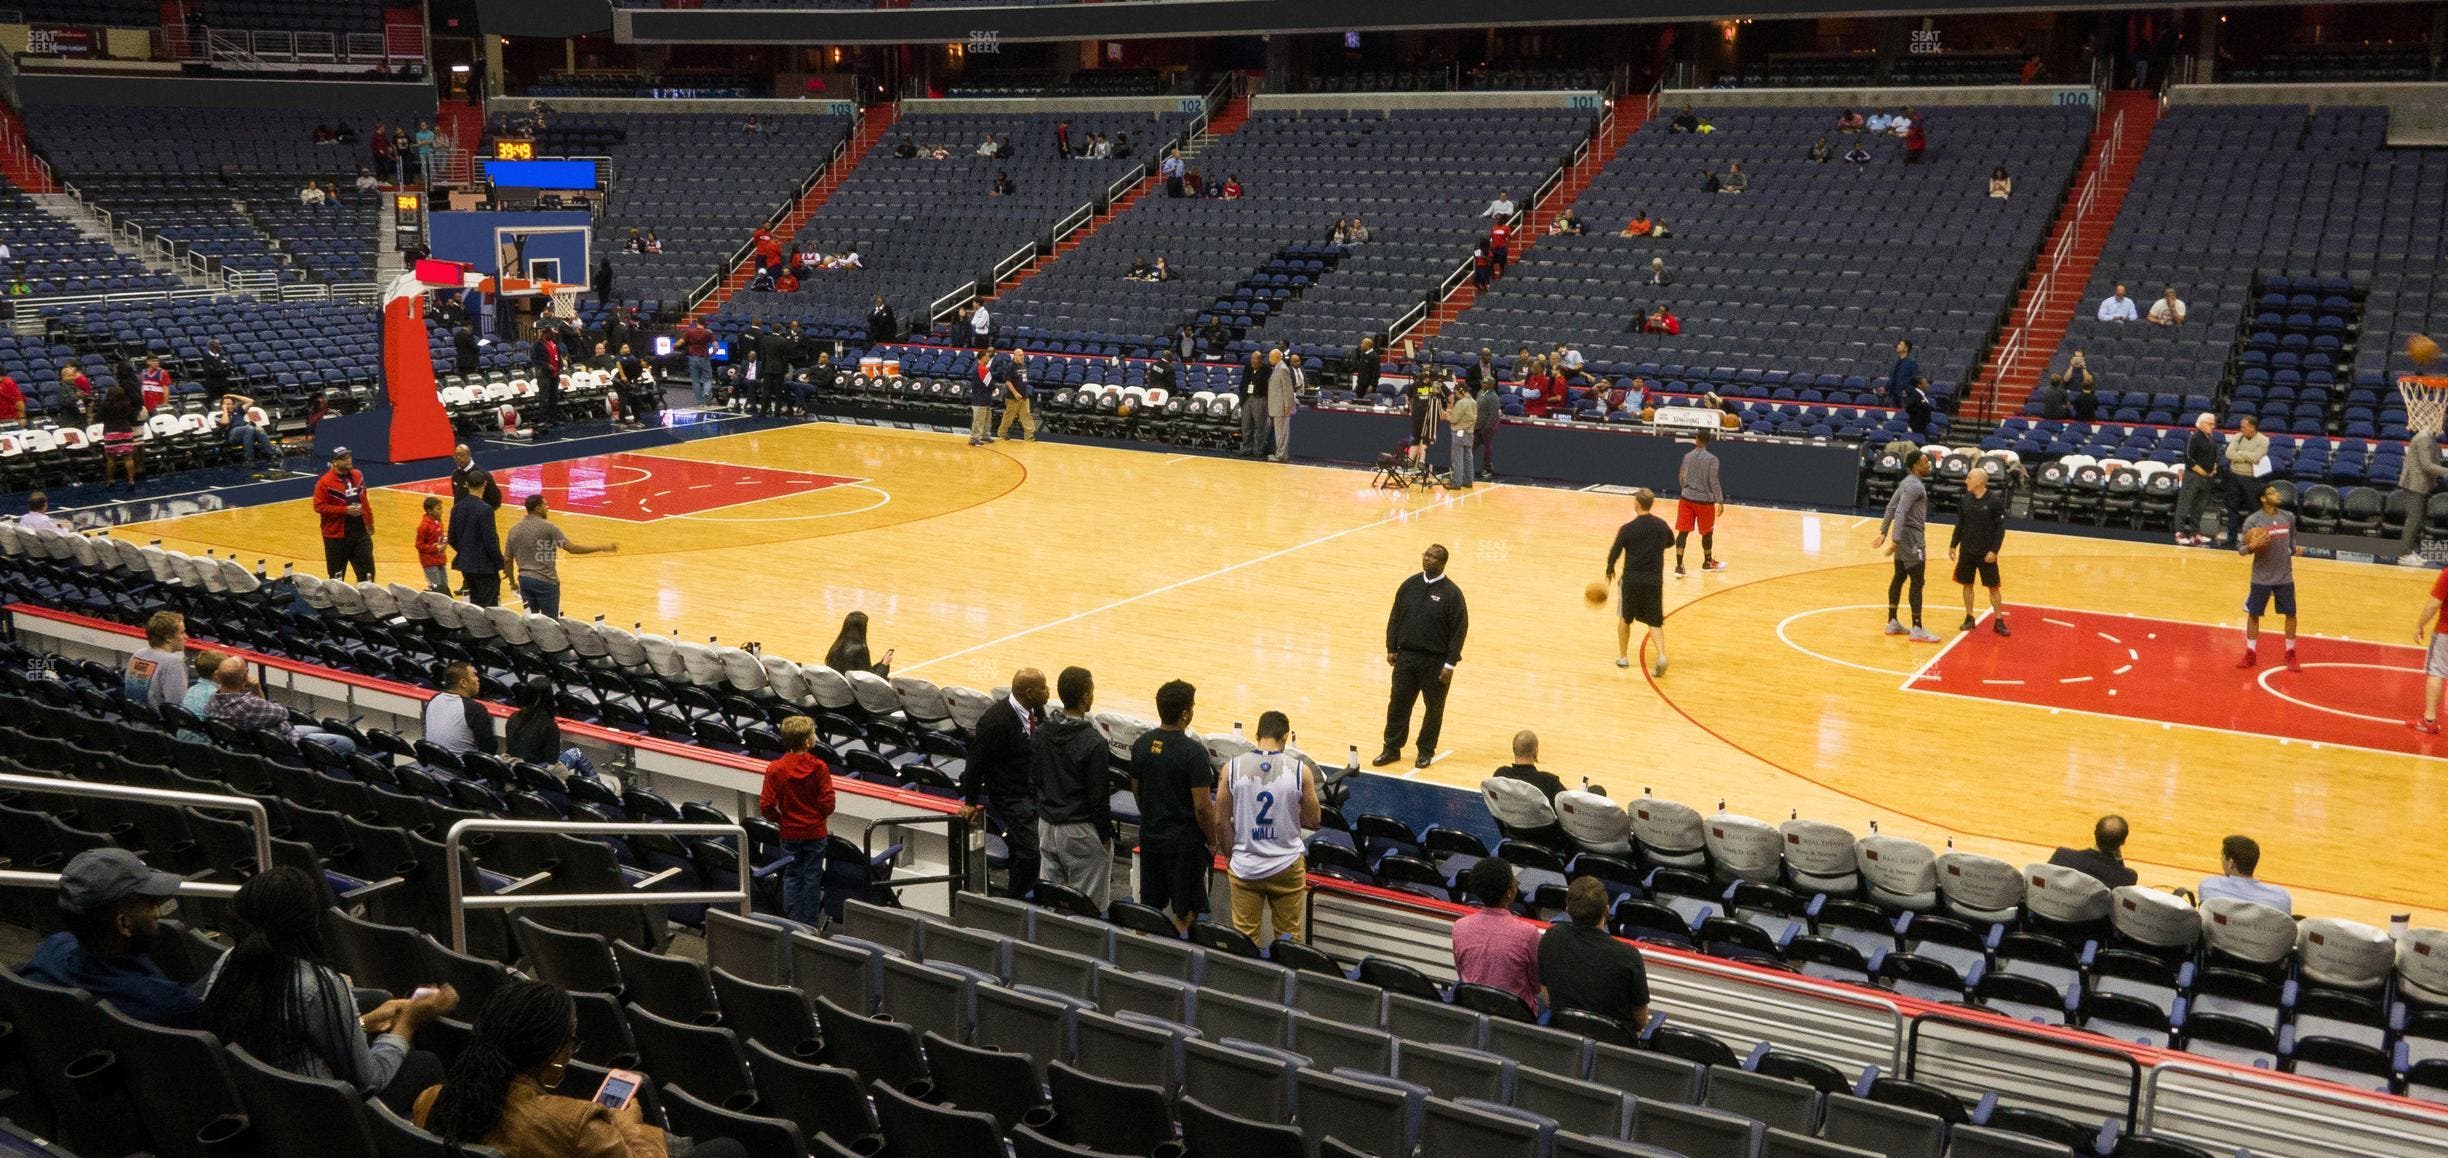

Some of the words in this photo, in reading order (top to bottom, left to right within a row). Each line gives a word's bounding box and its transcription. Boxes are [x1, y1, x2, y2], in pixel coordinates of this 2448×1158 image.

[1572, 96, 1594, 108] 101
[2058, 92, 2089, 106] 100
[831, 104, 851, 116] 103
[1182, 100, 1201, 113] 102
[499, 143, 531, 159] 39:49
[1256, 790, 1274, 826] 2
[1251, 827, 1278, 841] WALL
